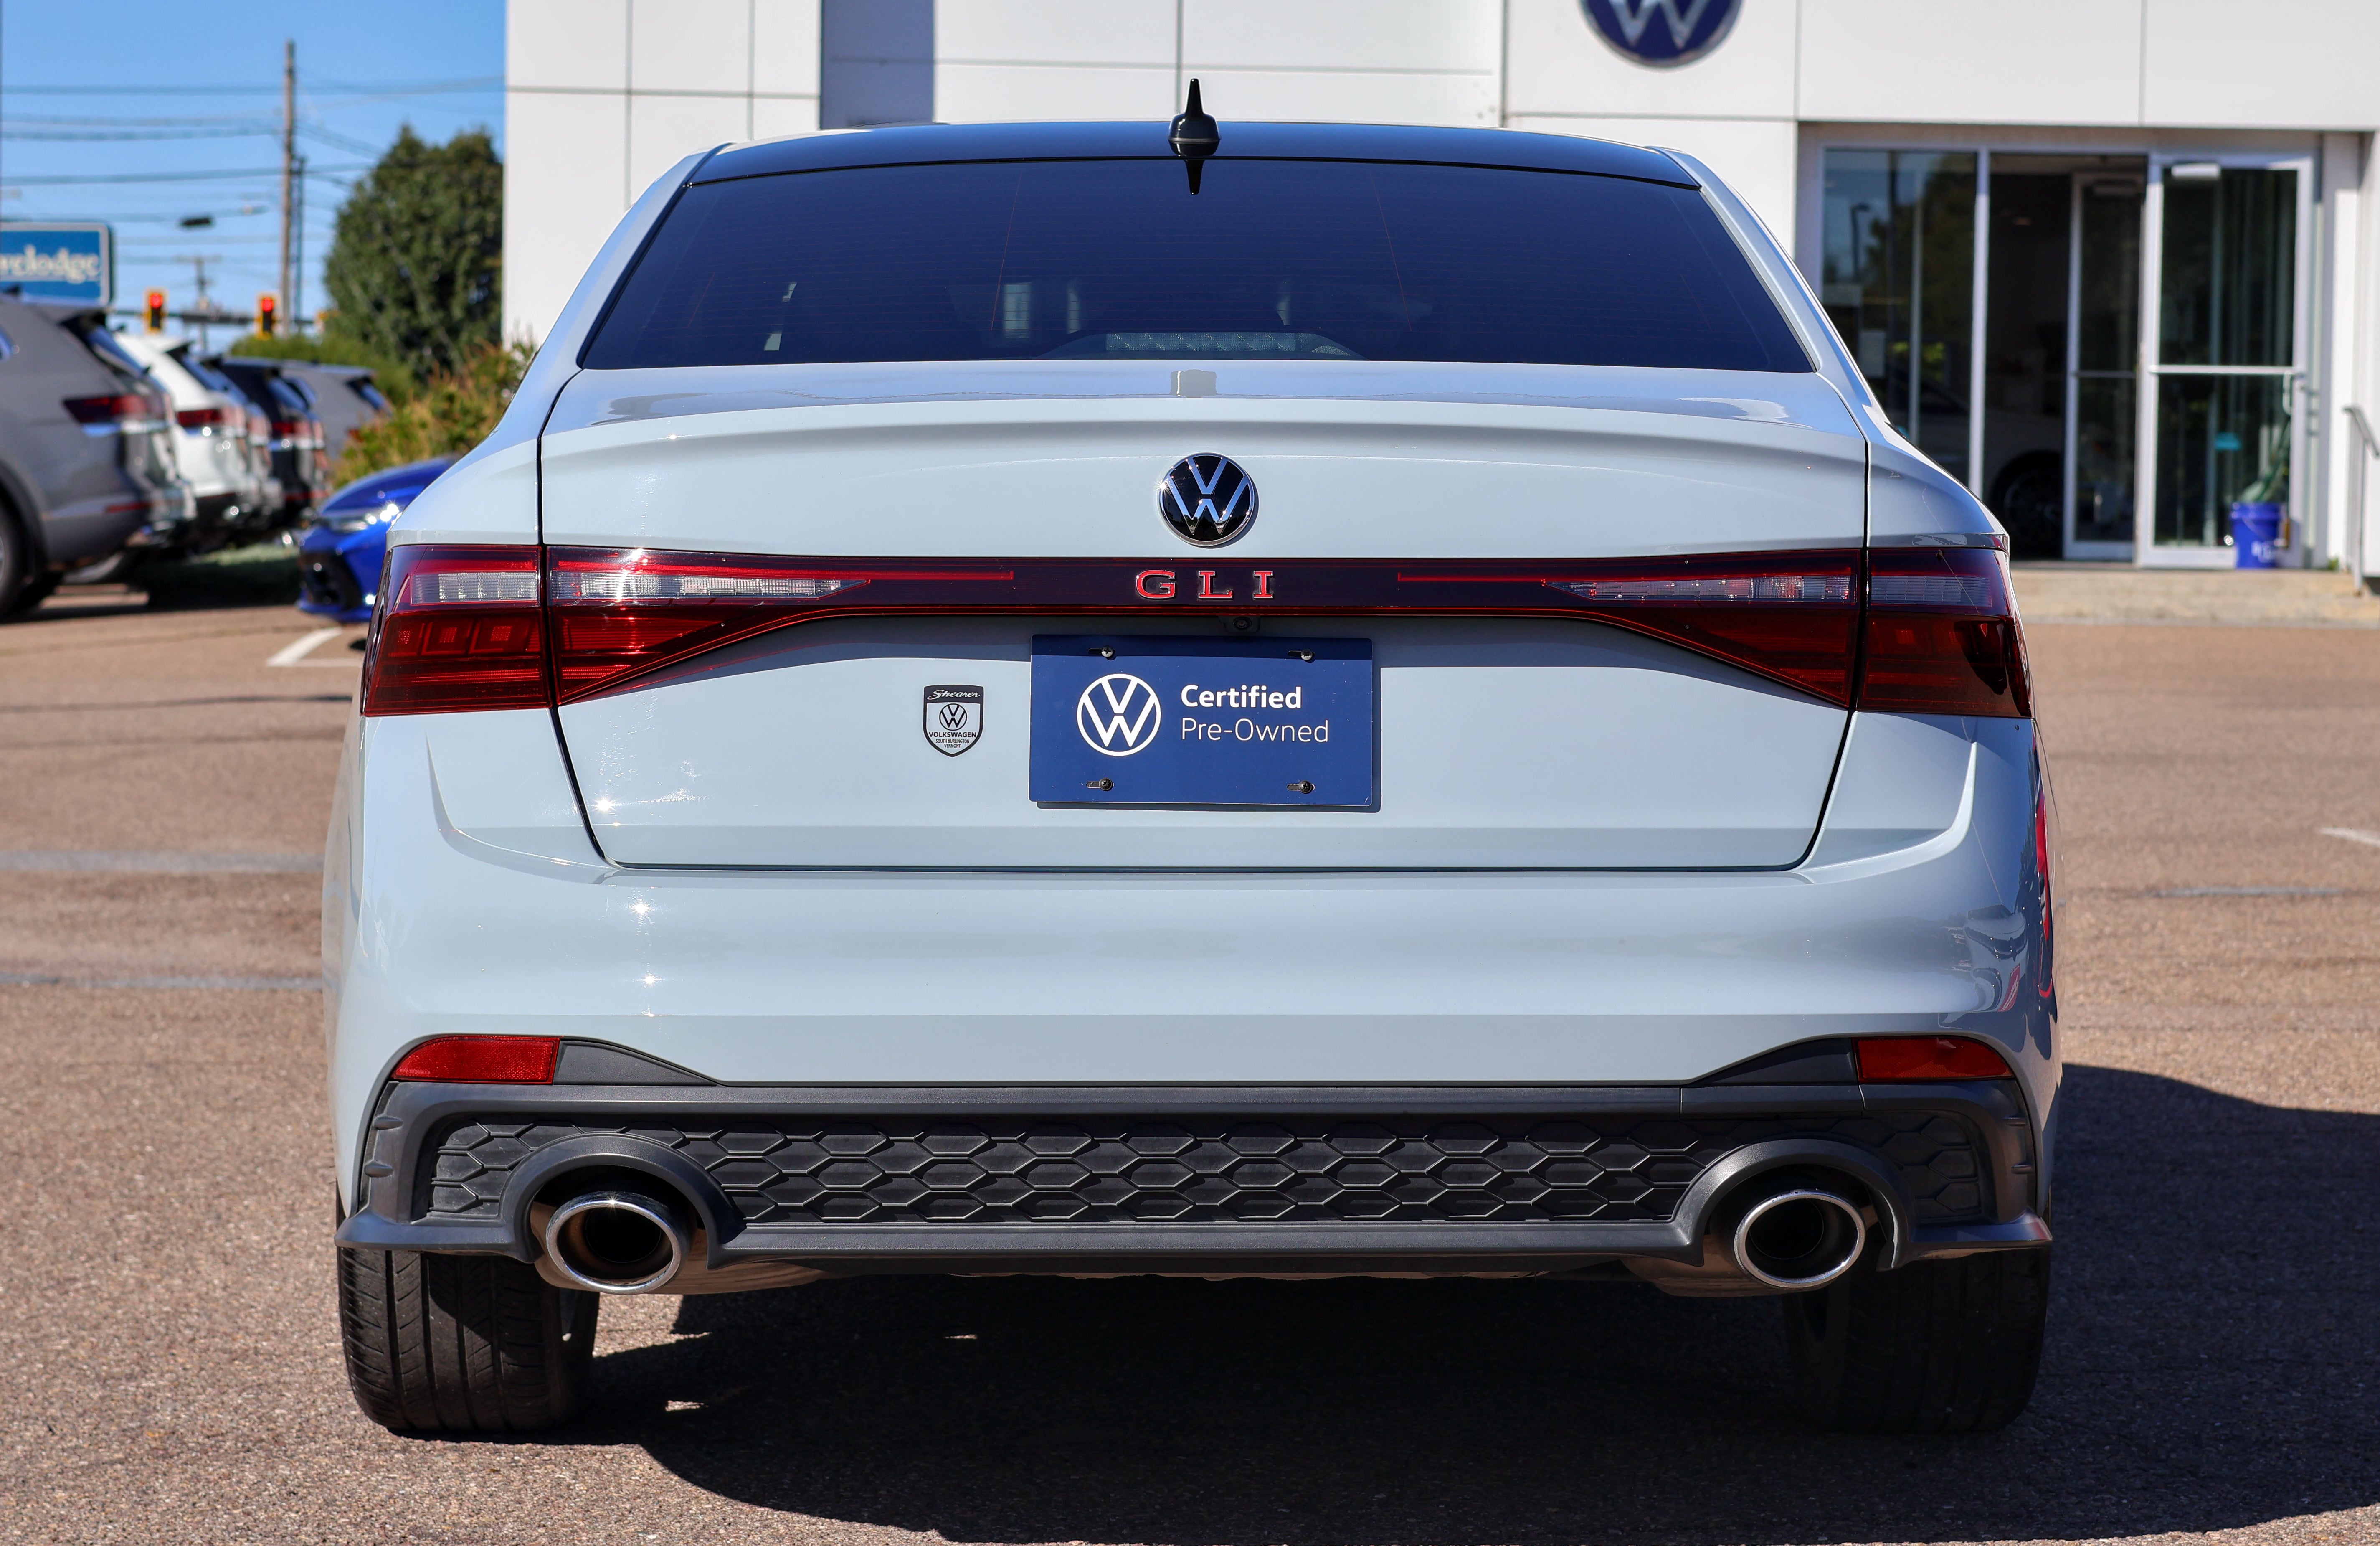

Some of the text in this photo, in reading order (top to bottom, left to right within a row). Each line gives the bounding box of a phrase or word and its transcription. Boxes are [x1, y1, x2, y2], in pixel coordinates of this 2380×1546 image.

[1136, 569, 1274, 599] GLI
[927, 689, 981, 700] Shearer
[1181, 685, 1302, 709] Certified
[1181, 718, 1329, 743] Pre-Owned
